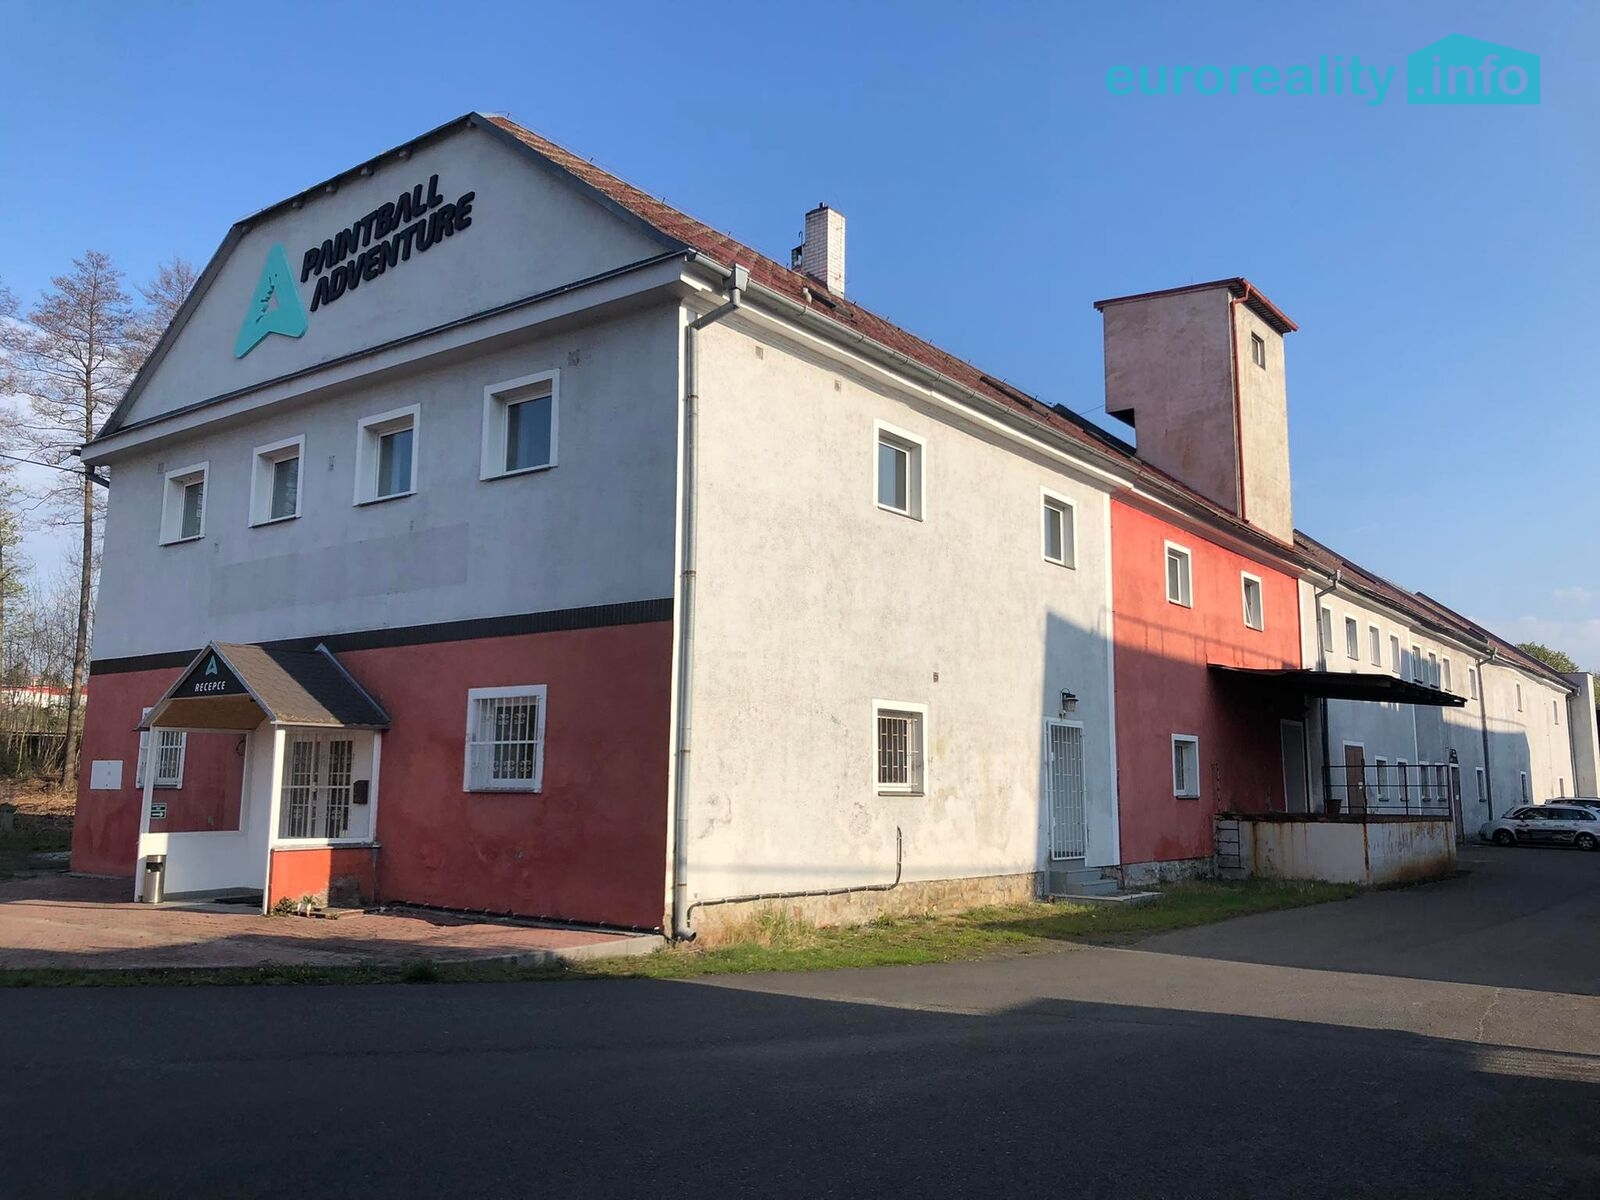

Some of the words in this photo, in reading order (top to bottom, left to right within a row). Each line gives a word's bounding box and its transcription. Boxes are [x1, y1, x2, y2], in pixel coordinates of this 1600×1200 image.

[300, 174, 444, 283] PAINTBALL
[310, 191, 475, 312] ADVENTURE
[194, 680, 226, 692] RECEPCE
